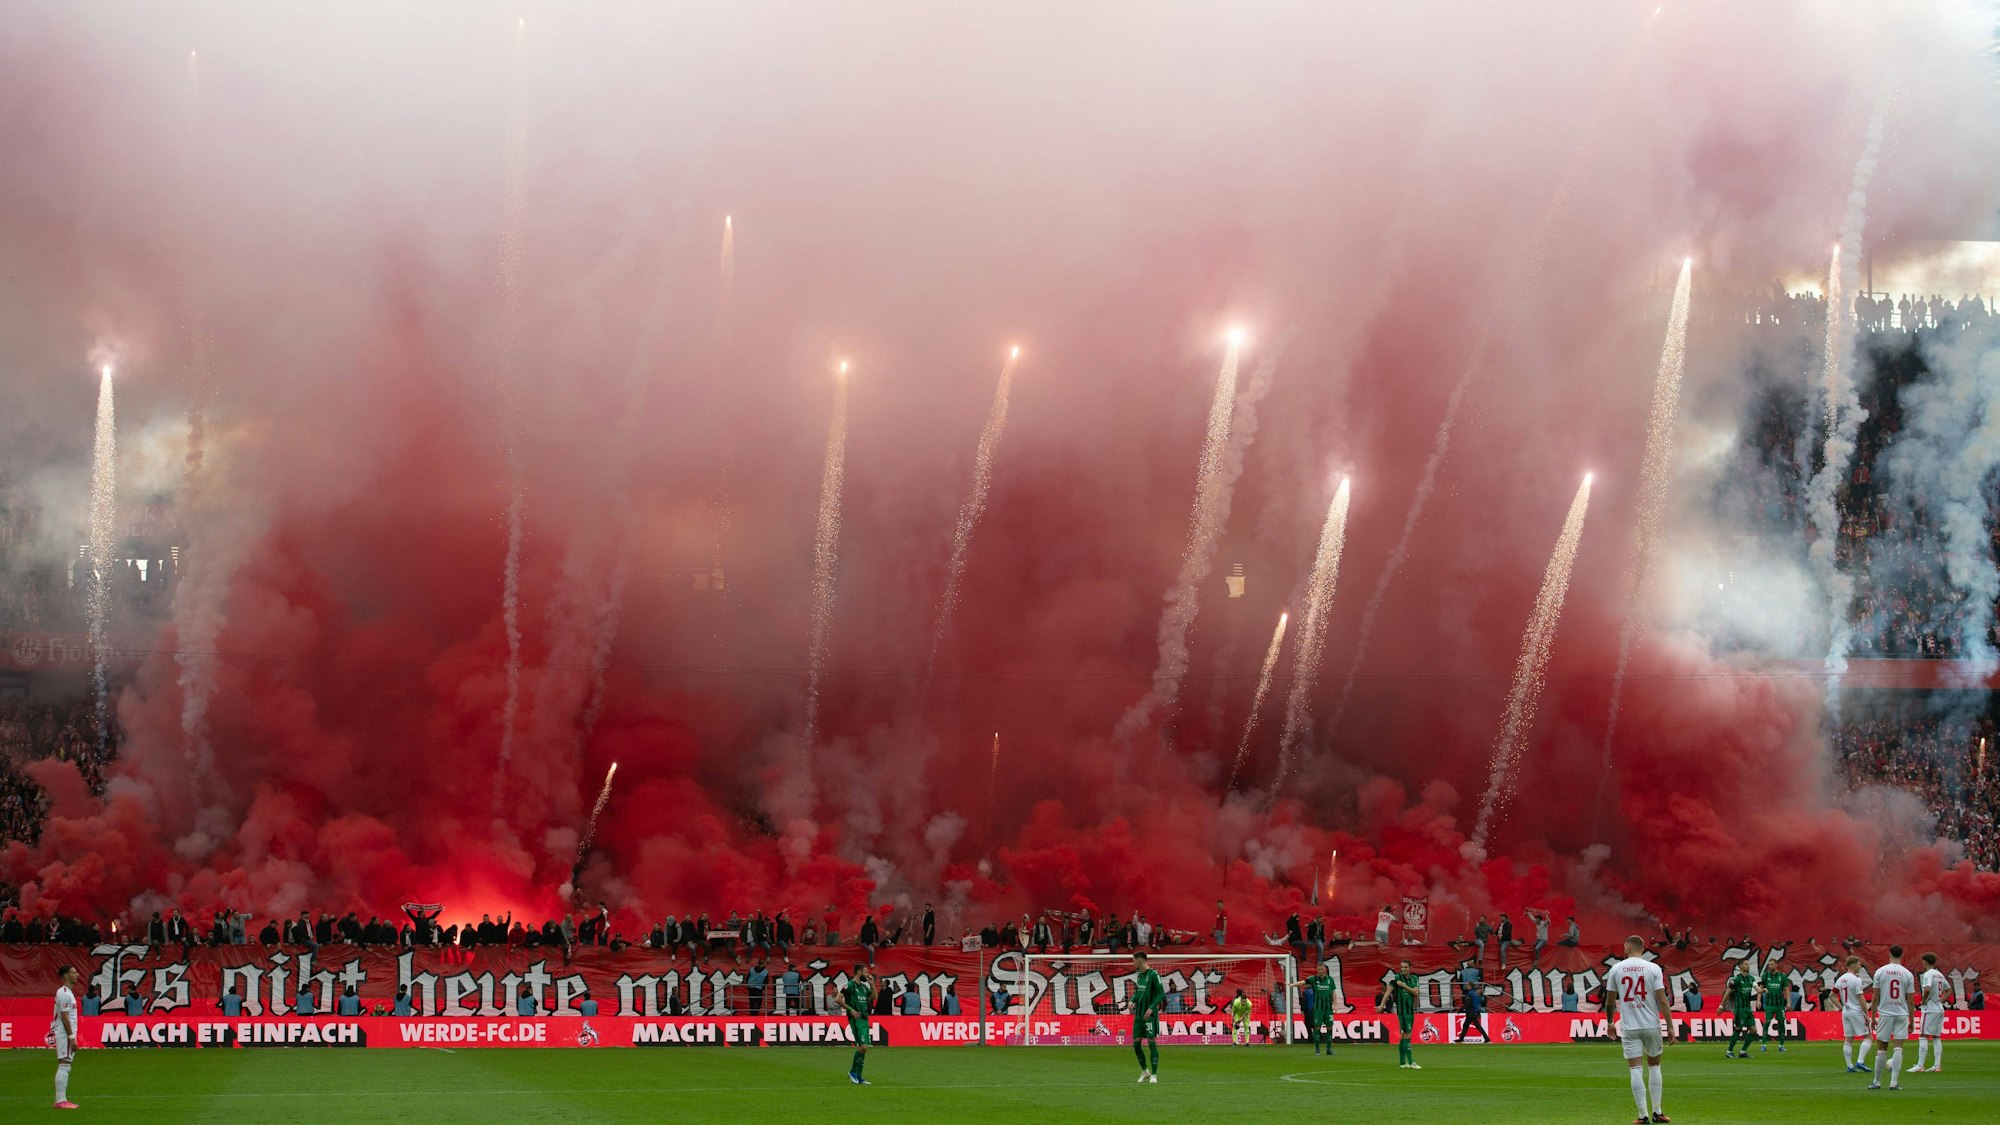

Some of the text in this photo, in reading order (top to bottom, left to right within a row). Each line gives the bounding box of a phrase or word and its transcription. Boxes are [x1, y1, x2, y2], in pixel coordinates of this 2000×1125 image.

[91, 945, 190, 1013] Es
[394, 951, 590, 1017] heute
[616, 967, 744, 1017] nur
[1621, 976, 1647, 1002] 24
[1890, 979, 1900, 999] 6
[101, 1023, 359, 1042] MACH ET EINFACH
[400, 1023, 547, 1042] WERDE-FC.DE
[632, 1023, 716, 1042] MACH
[725, 1023, 756, 1042] ET
[1145, 1022, 1153, 1031] 31
